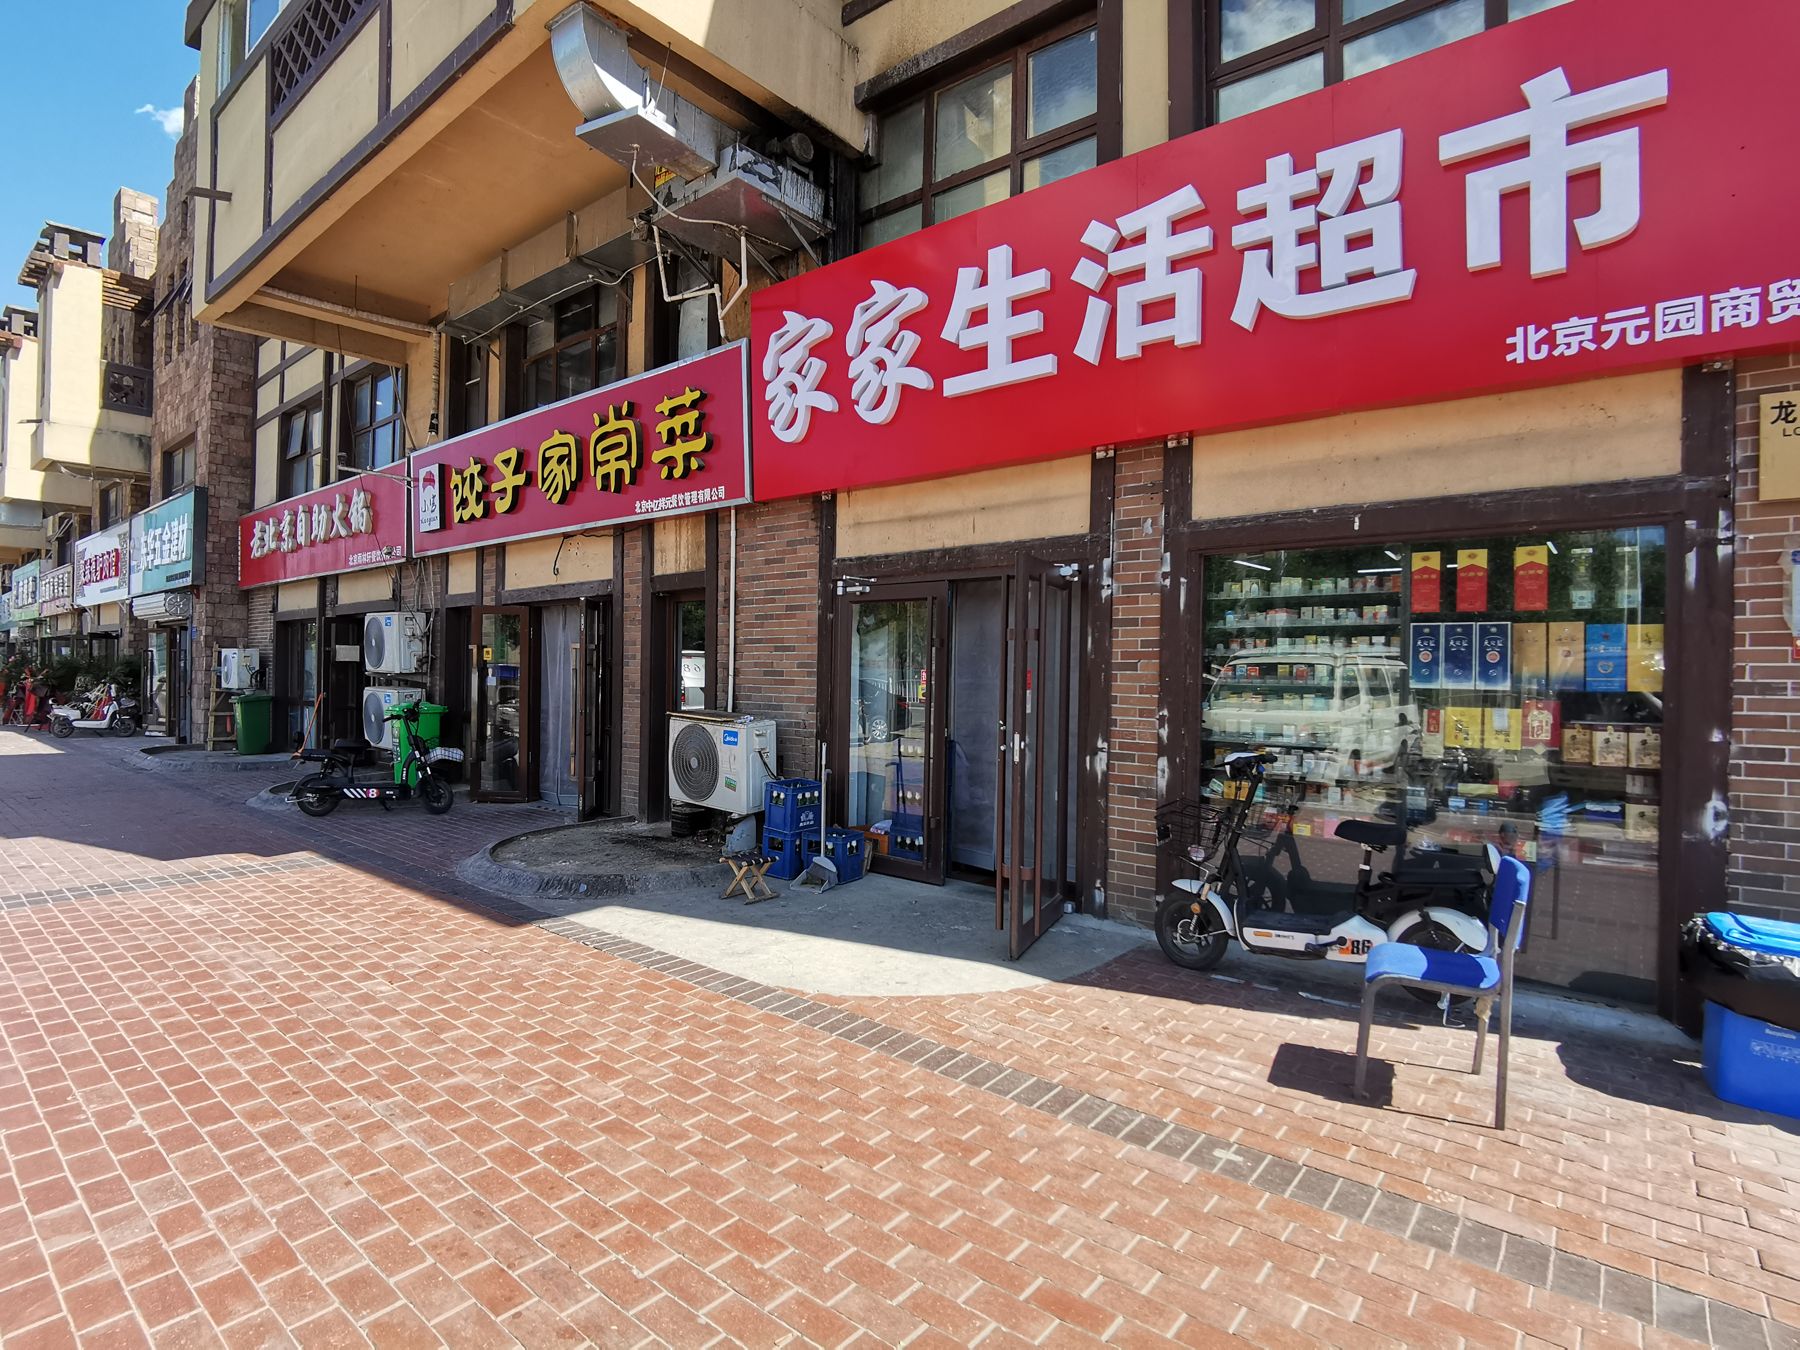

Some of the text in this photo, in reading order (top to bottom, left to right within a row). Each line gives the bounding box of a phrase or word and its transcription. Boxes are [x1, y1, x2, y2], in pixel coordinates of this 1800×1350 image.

[762, 66, 1670, 443] 家家生活超市
[1505, 278, 1800, 365] 北京元园商贸
[449, 386, 710, 522] 饺子家常菜
[1770, 400, 1797, 425] 龙
[249, 487, 374, 559] 老北京自助火锅
